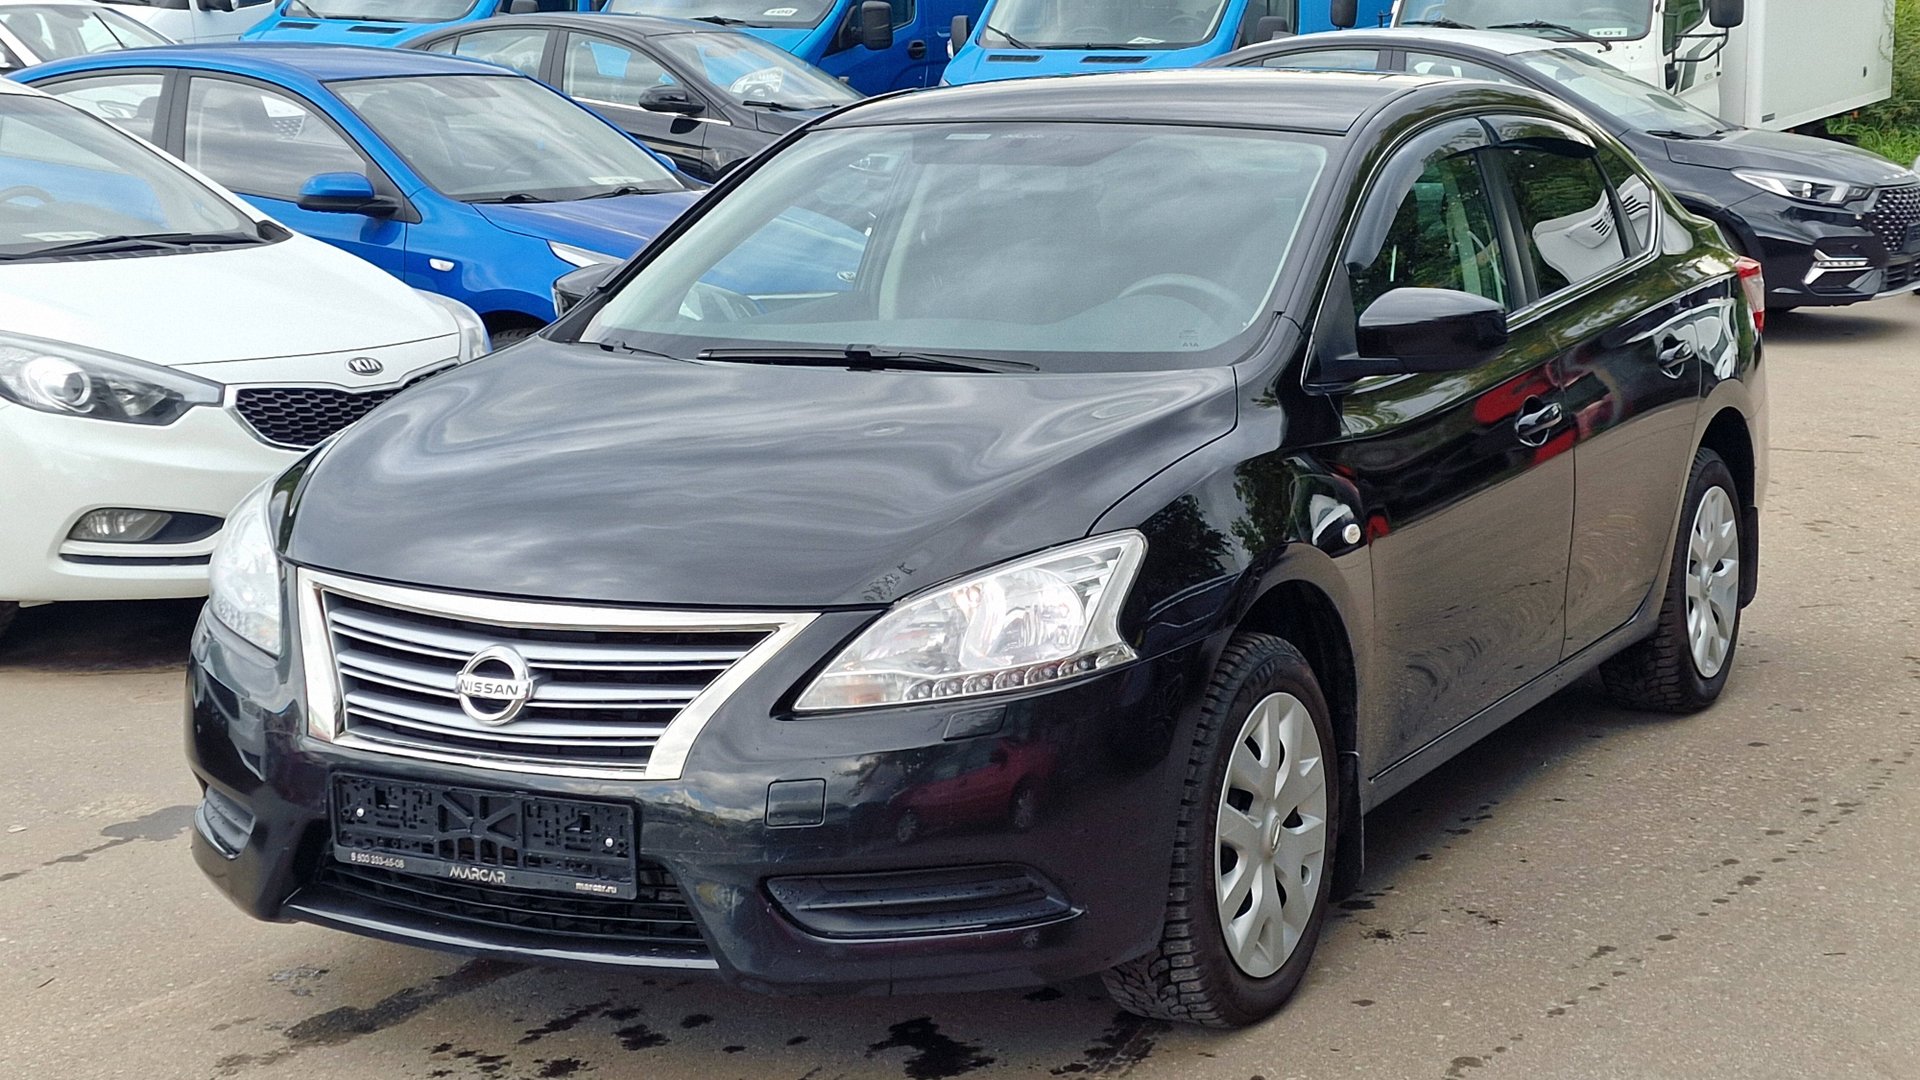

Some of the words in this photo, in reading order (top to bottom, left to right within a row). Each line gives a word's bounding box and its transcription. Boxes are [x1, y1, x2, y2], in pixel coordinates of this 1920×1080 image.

[350, 358, 381, 372] KIA
[460, 679, 519, 695] NISSAN
[449, 866, 506, 884] MARCAR
